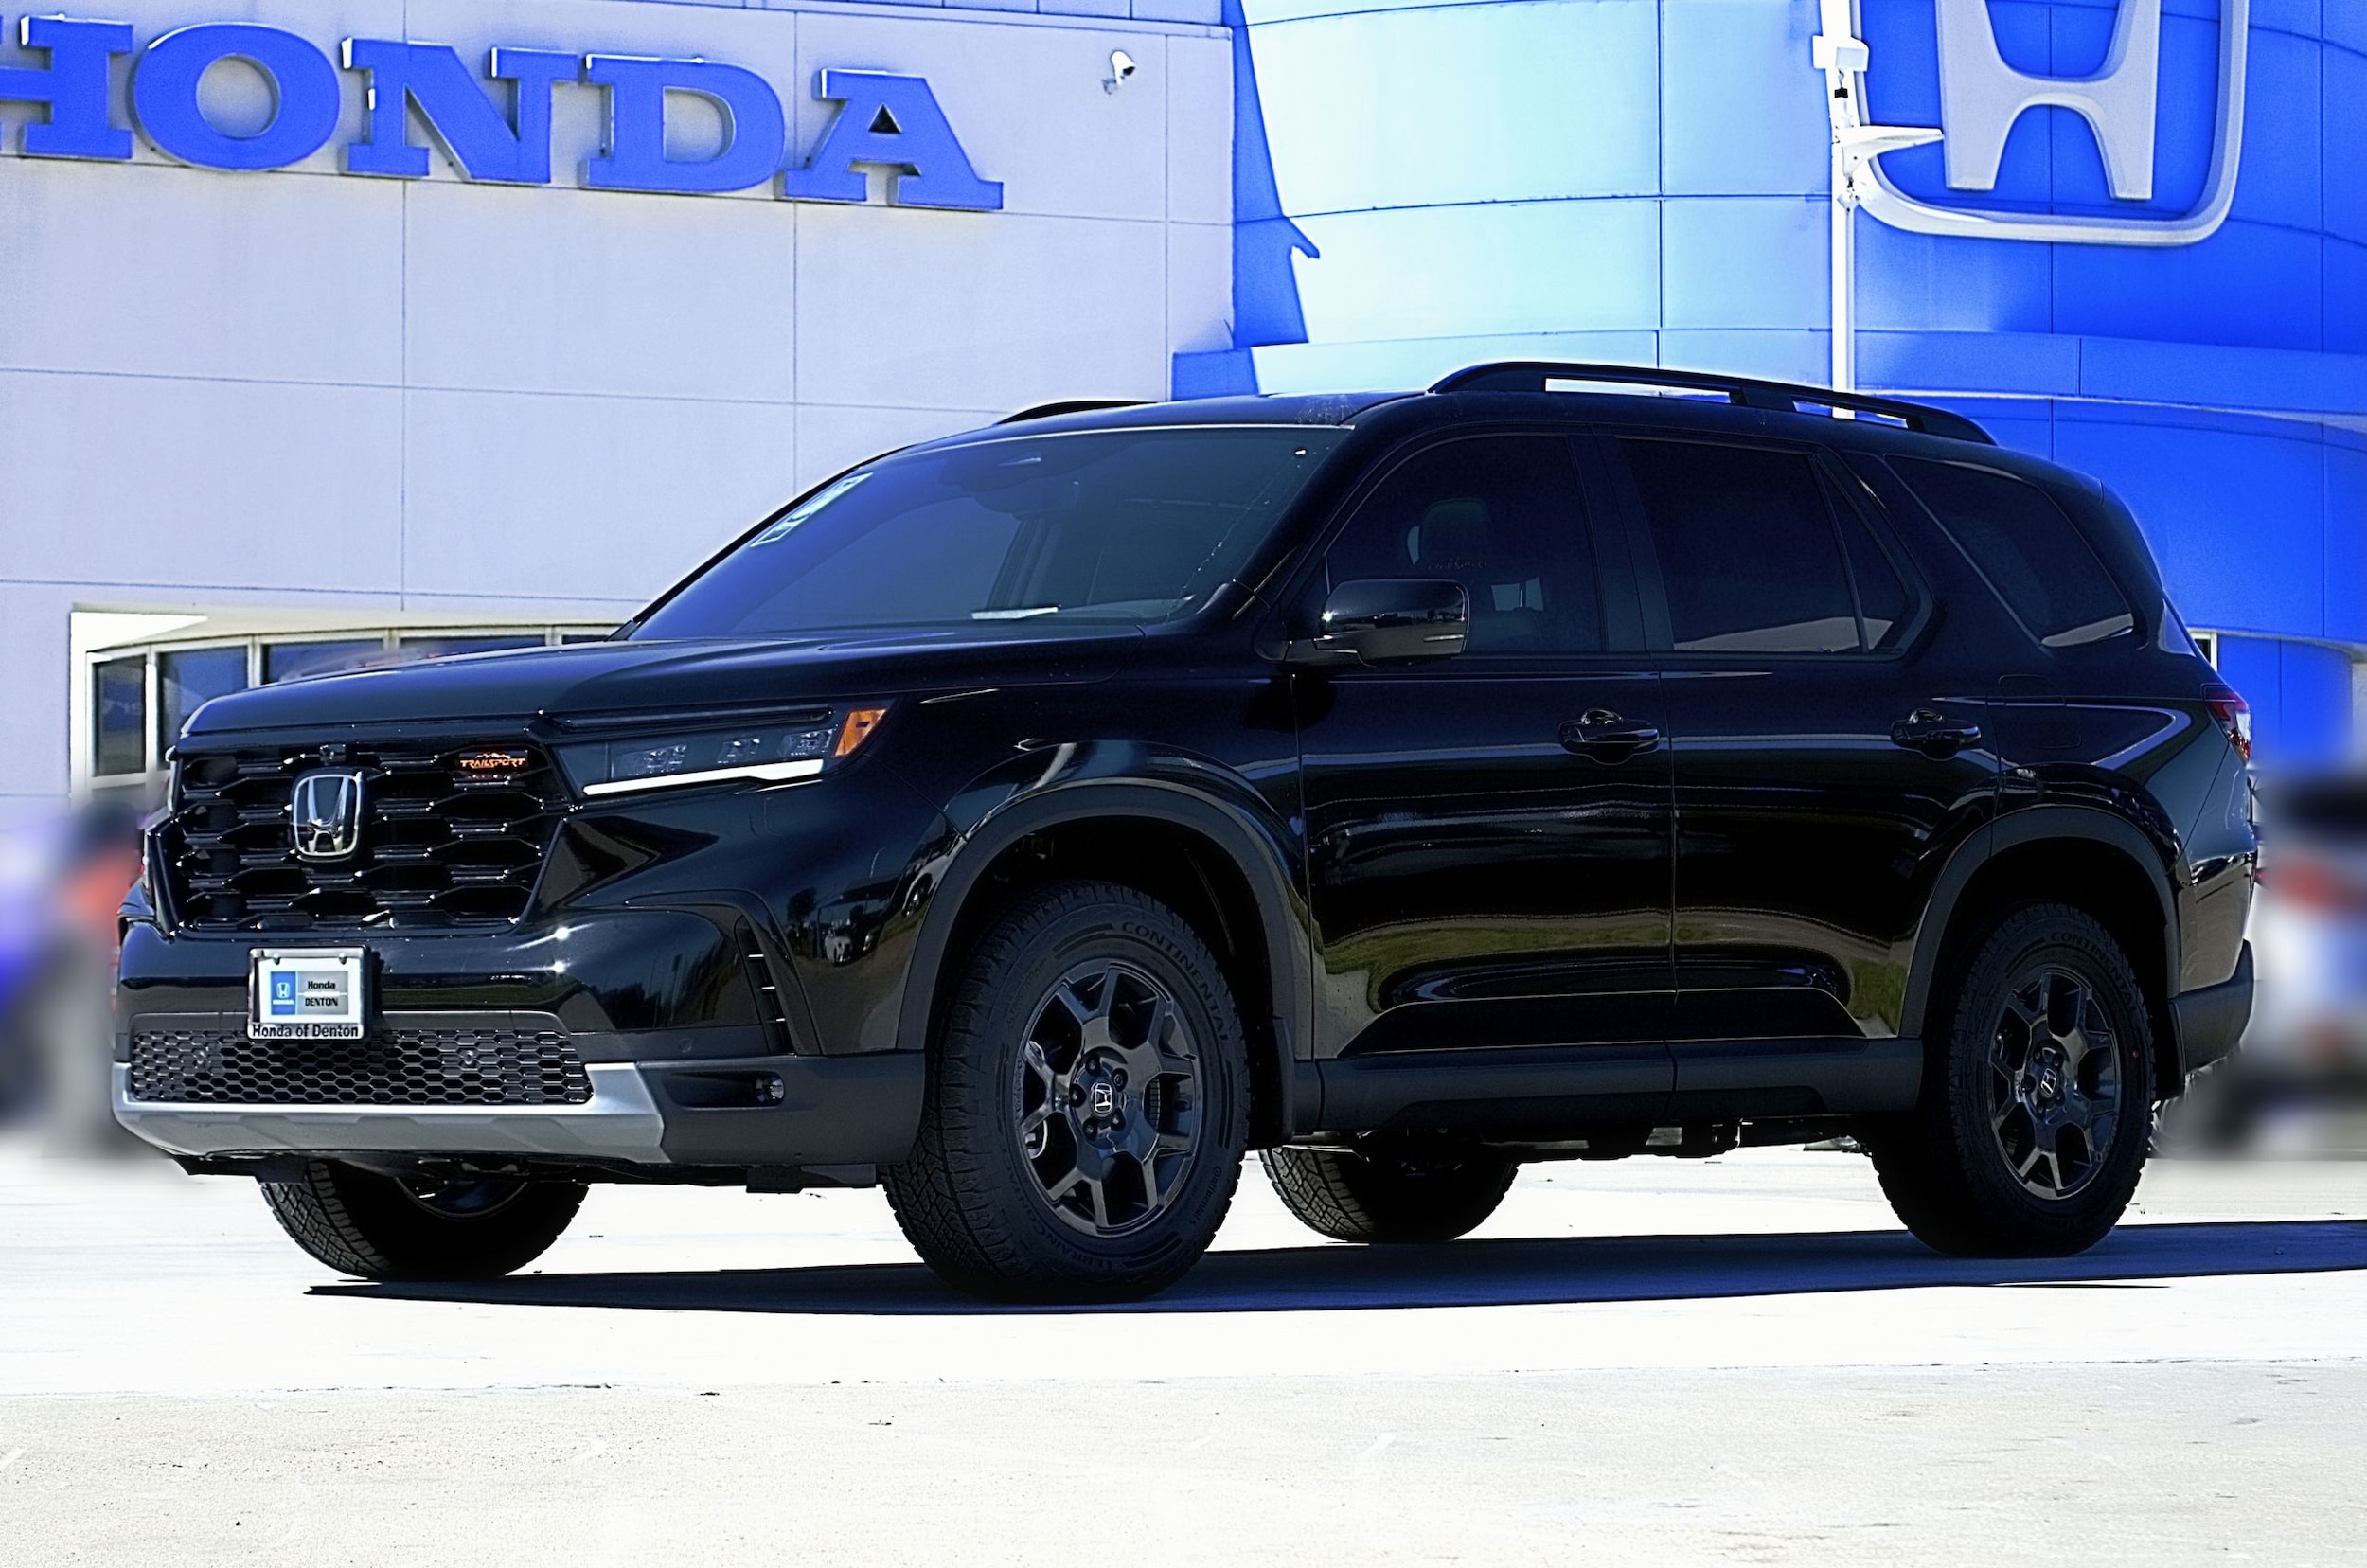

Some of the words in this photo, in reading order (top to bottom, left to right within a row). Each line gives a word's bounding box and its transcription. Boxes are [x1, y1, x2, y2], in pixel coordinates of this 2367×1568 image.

[0, 13, 1004, 211] HONDA
[460, 758, 526, 768] TRAILSPORT
[308, 981, 336, 989] Honda
[1123, 921, 1228, 1041] CONTINENTAL
[305, 998, 339, 1007] DENTON
[253, 1023, 292, 1037] Honda
[295, 1023, 310, 1037] of
[311, 1023, 359, 1037] Denton
